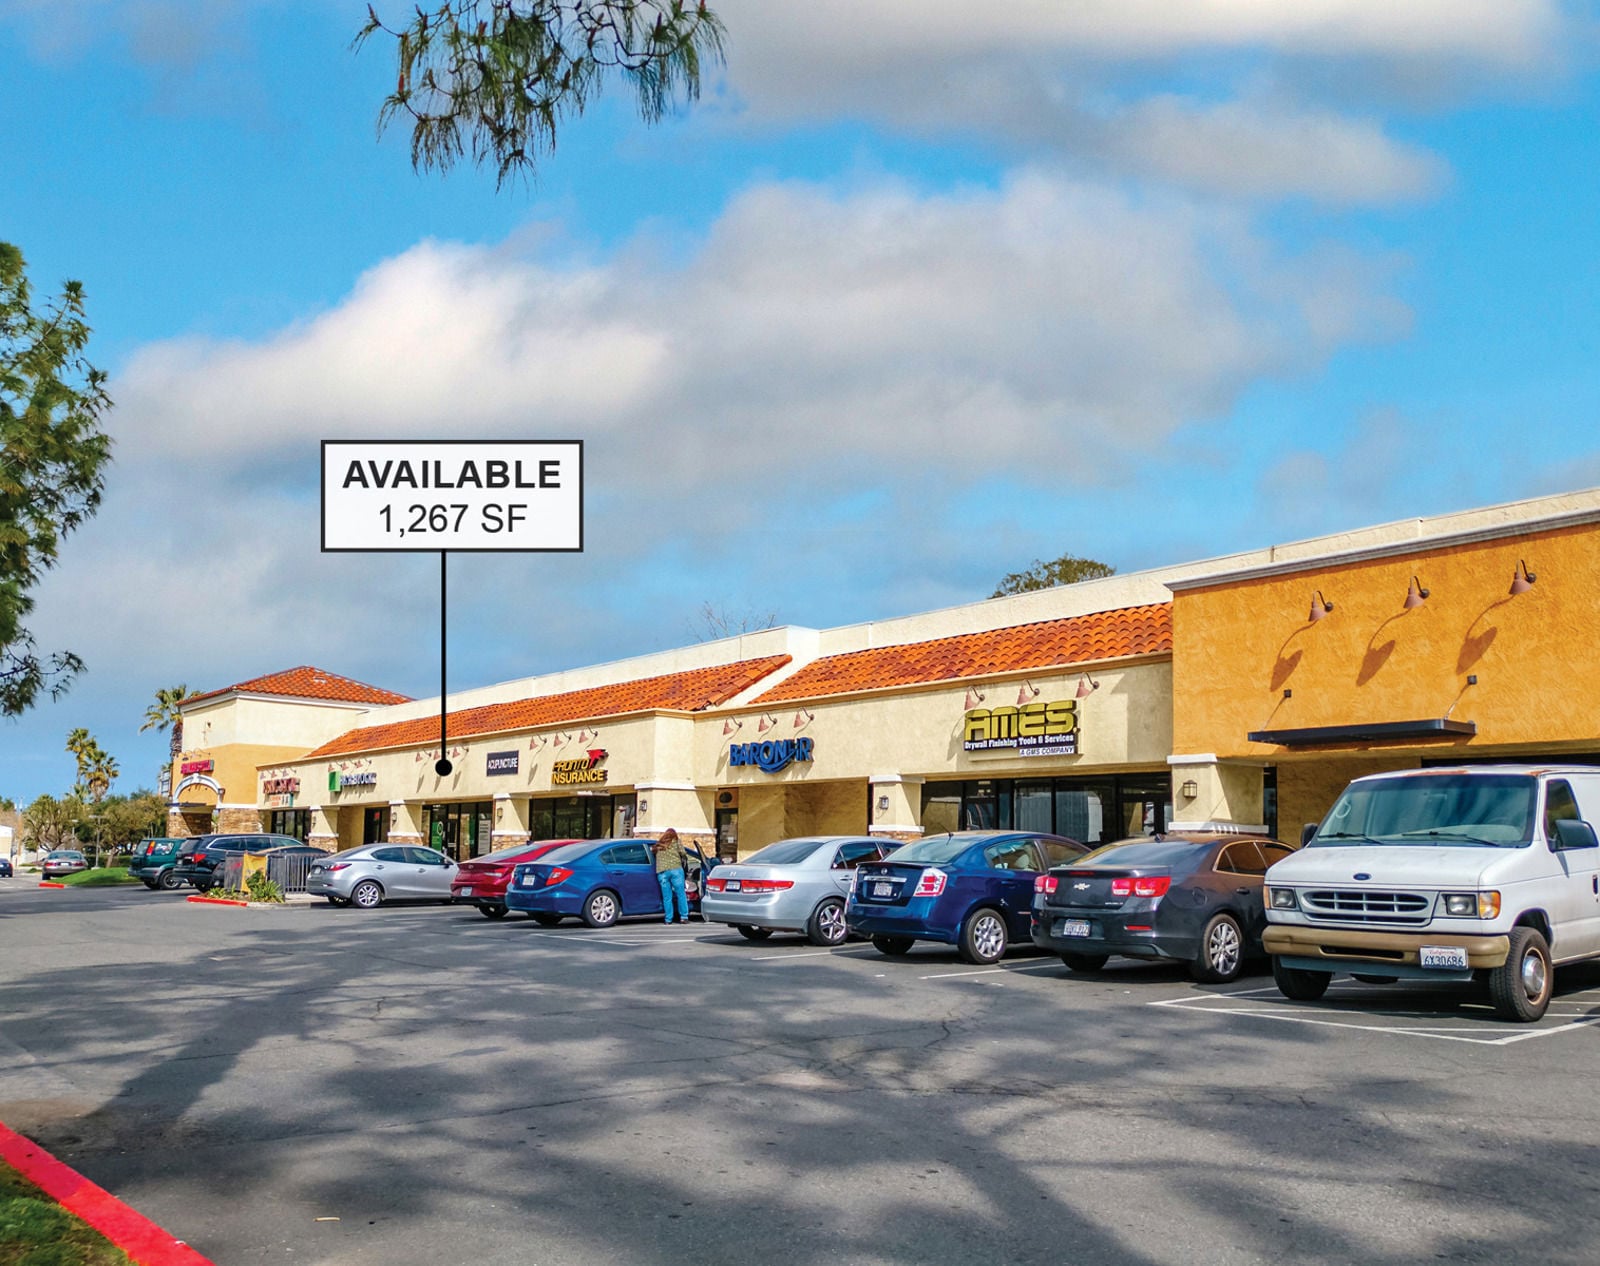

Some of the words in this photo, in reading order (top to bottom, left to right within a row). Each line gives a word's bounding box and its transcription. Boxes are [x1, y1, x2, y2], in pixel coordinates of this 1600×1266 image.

[965, 700, 1077, 741] AMES
[965, 740, 988, 750] Drywall
[988, 738, 1018, 748] Finishing
[1019, 736, 1037, 746] Tools
[1045, 734, 1075, 744] Services
[1026, 748, 1040, 756] GMS
[1041, 746, 1074, 755] COMPANY
[488, 758, 518, 770] ACUPUNCTURE
[551, 769, 606, 785] INSURANCE
[1423, 955, 1465, 967] 6X30686
